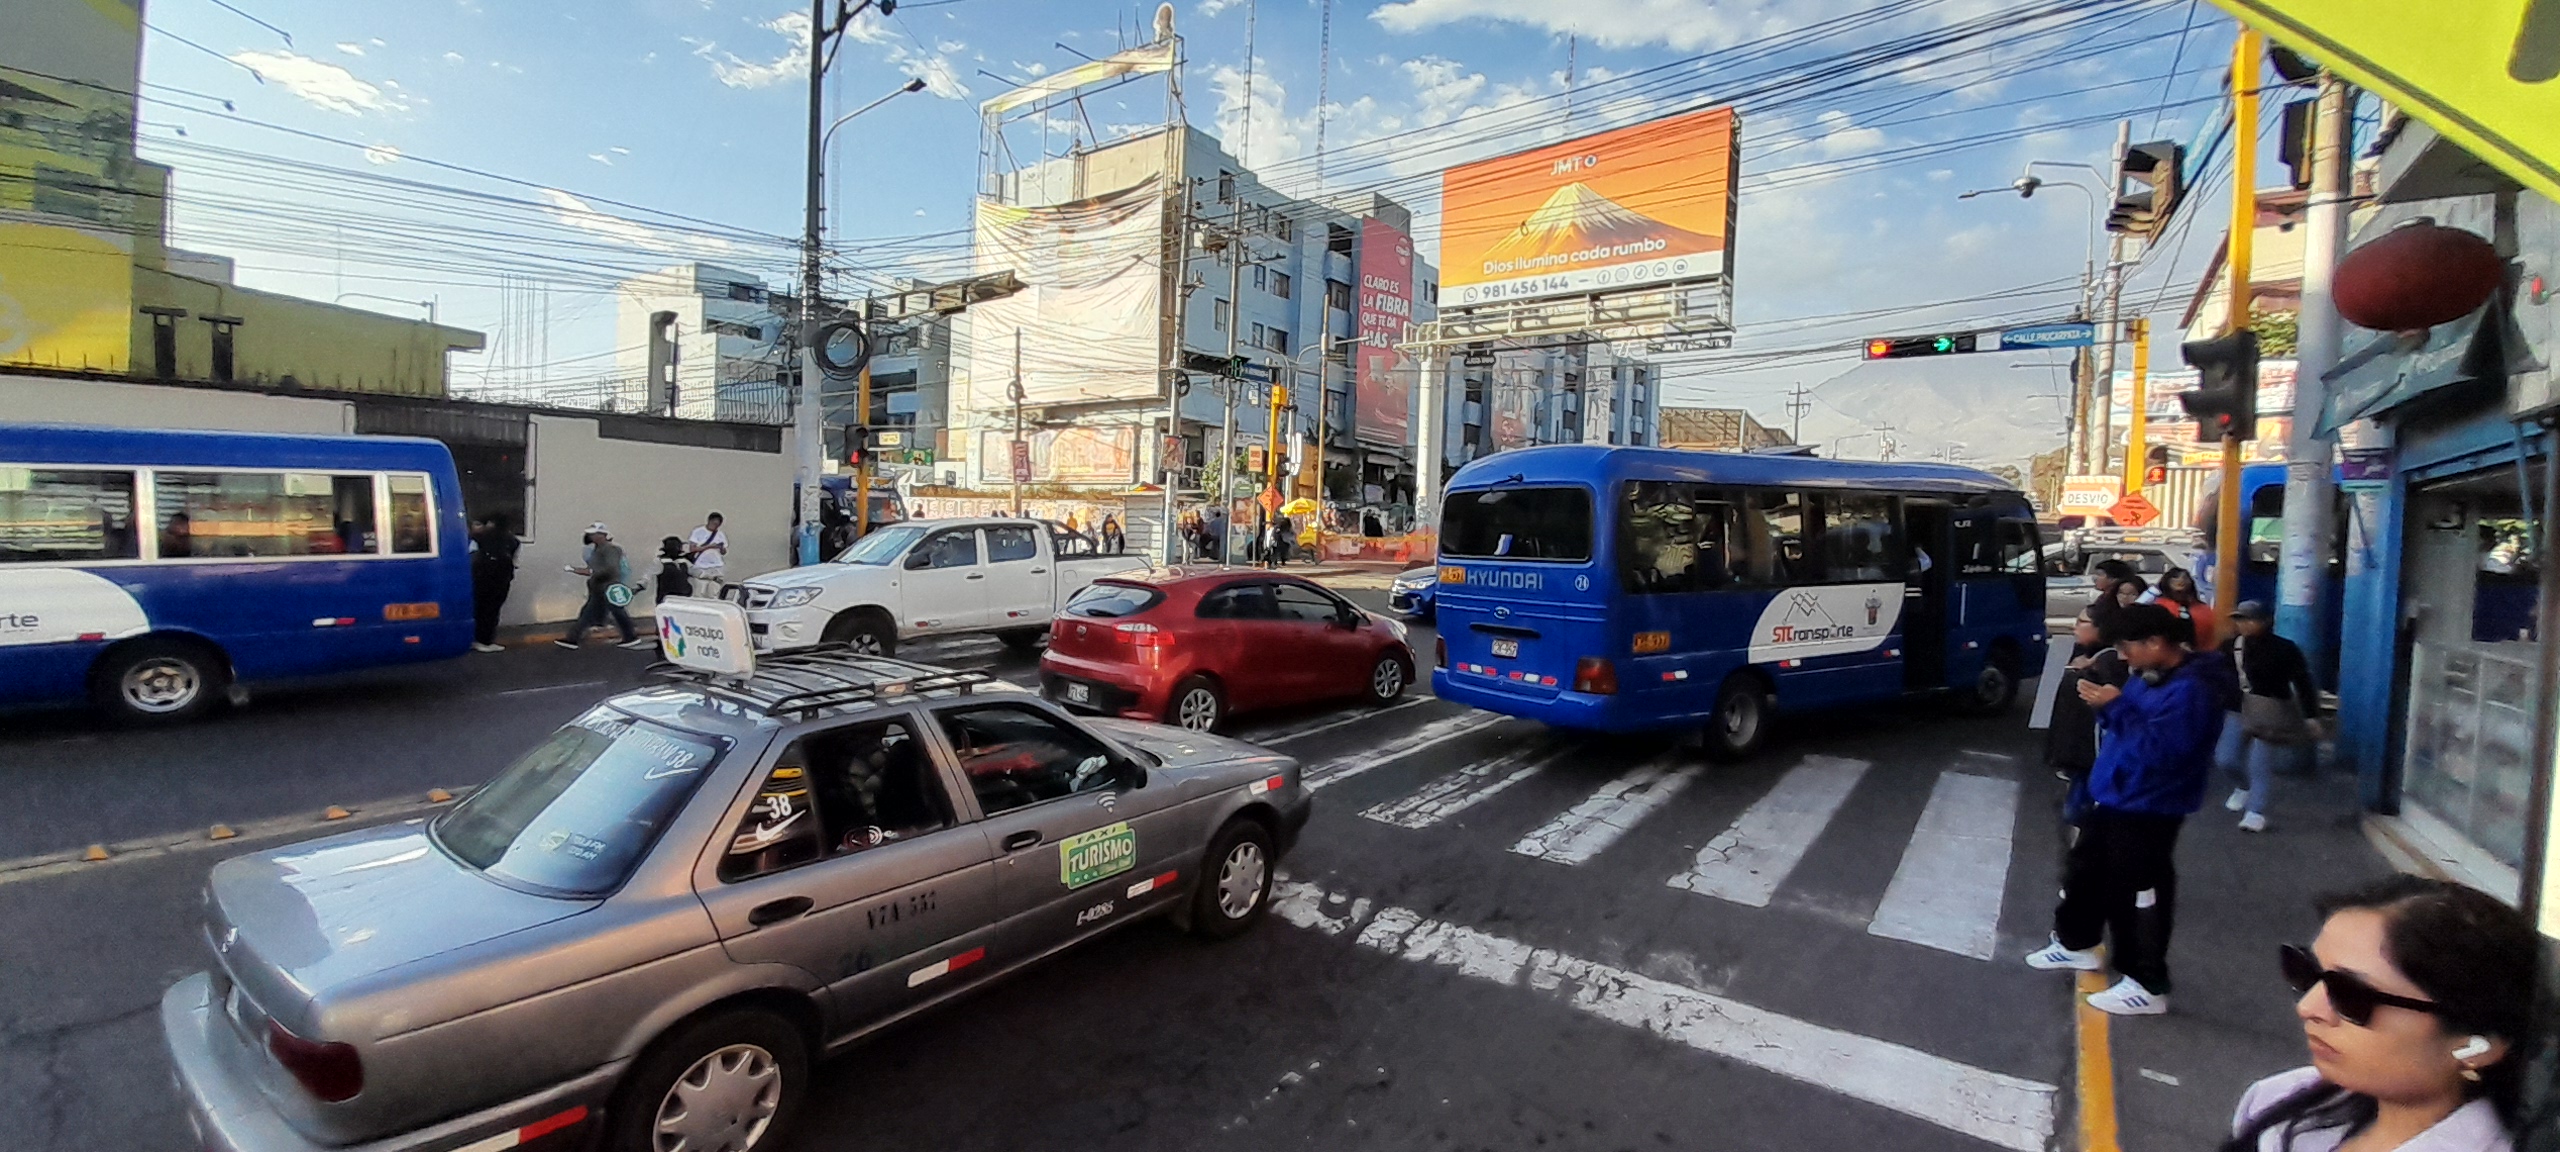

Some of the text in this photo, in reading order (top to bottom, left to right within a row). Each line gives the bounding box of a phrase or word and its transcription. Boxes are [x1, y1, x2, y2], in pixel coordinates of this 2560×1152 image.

[1550, 156, 1583, 176] JMT
[1483, 260, 1513, 275] Dios
[1570, 245, 1610, 262] cada
[1612, 237, 1666, 257] rumbo
[1363, 274, 1400, 294] CLARO ES
[1482, 276, 1570, 299] 981 456 144
[1363, 293, 1409, 317] LA FIBRA
[1362, 312, 1377, 326] QUE
[1378, 314, 1387, 327] TE
[2068, 493, 2109, 504] DESVIO
[1467, 569, 1543, 590] HYUNDAI
[685, 625, 724, 640] arequipa
[697, 645, 720, 659] norte
[767, 793, 793, 820] 38
[1076, 827, 1117, 845] TAXI
[1069, 838, 1133, 873] TURISMO
